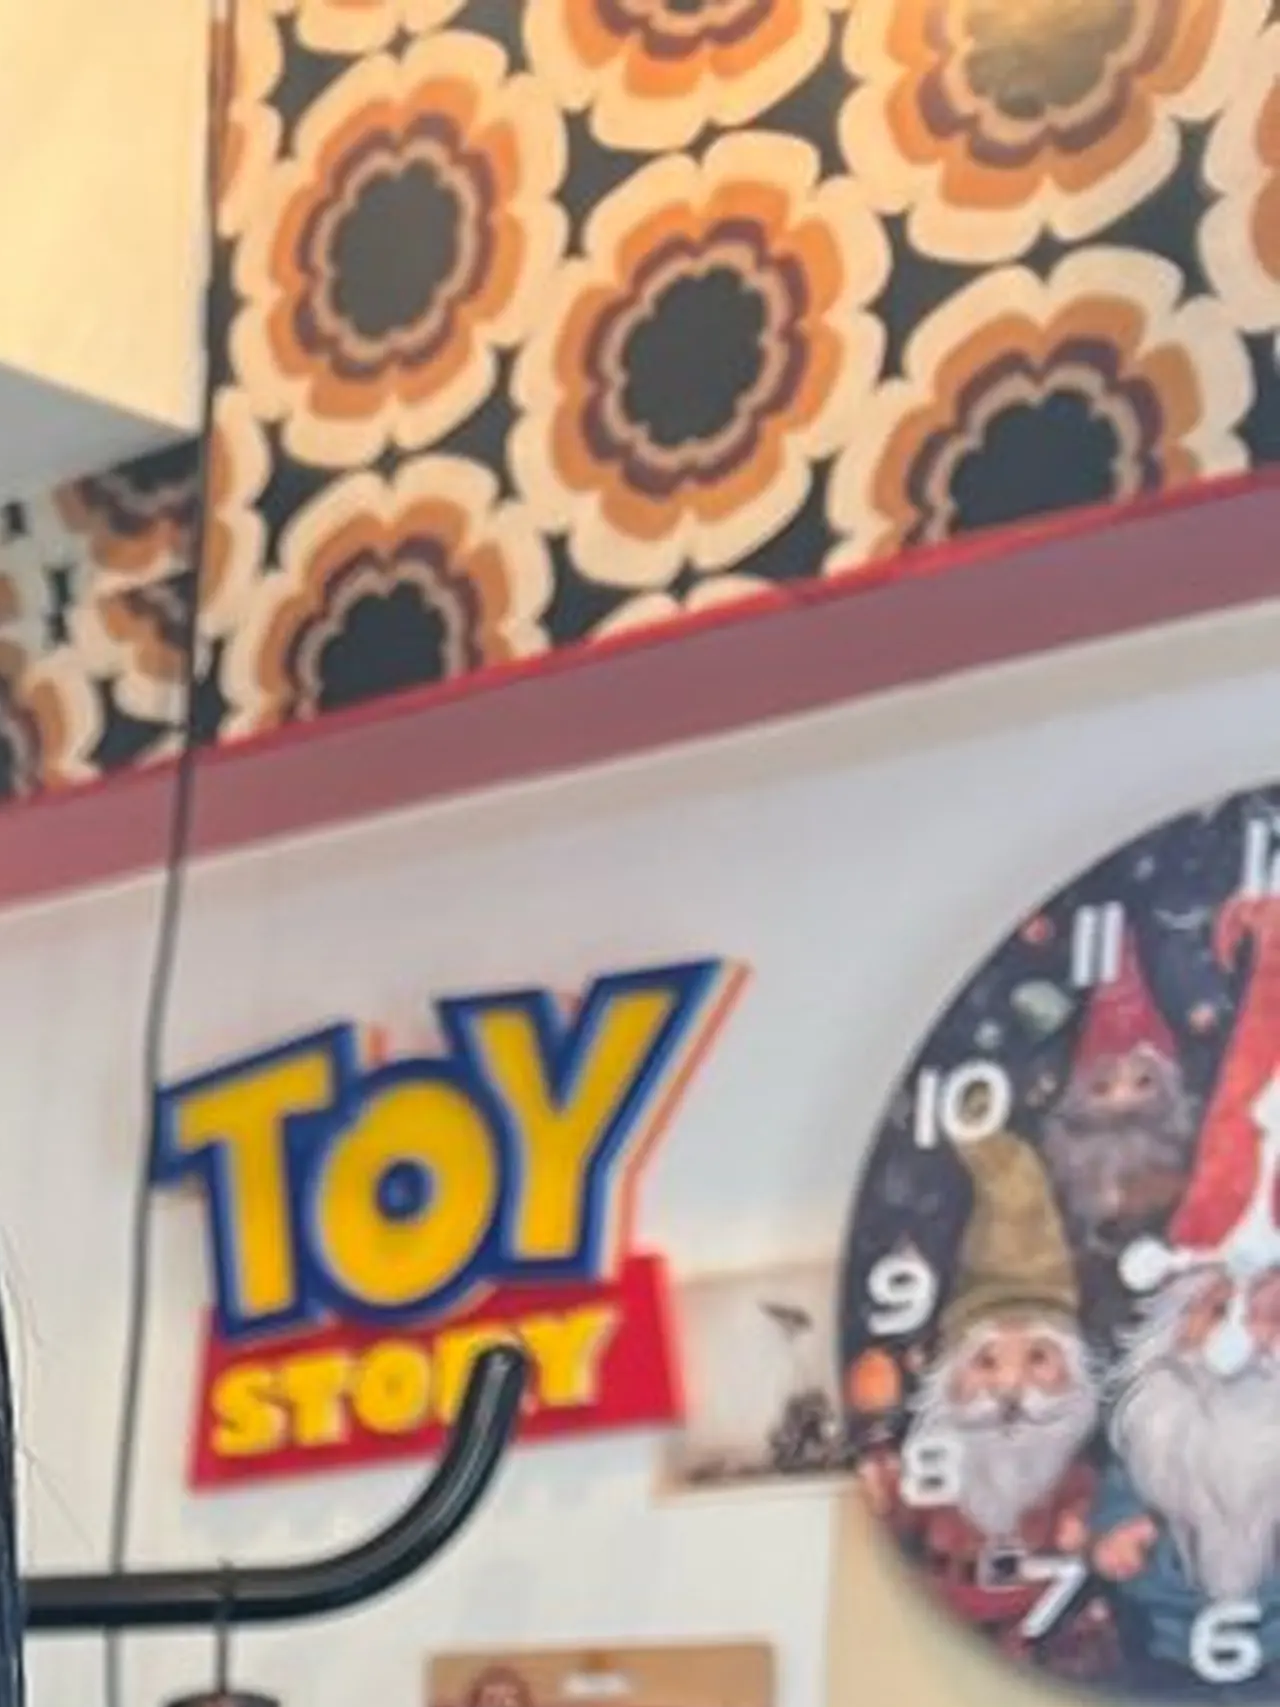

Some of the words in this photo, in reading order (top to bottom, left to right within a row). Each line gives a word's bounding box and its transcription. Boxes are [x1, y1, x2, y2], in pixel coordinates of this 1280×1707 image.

[1072, 901, 1126, 987] 11
[914, 1060, 1012, 1150] 10
[158, 966, 702, 1328] TOY
[868, 1254, 936, 1336] 9
[900, 1436, 964, 1508] 8
[1017, 1555, 1087, 1638] 7
[1188, 1602, 1263, 1684] 6
